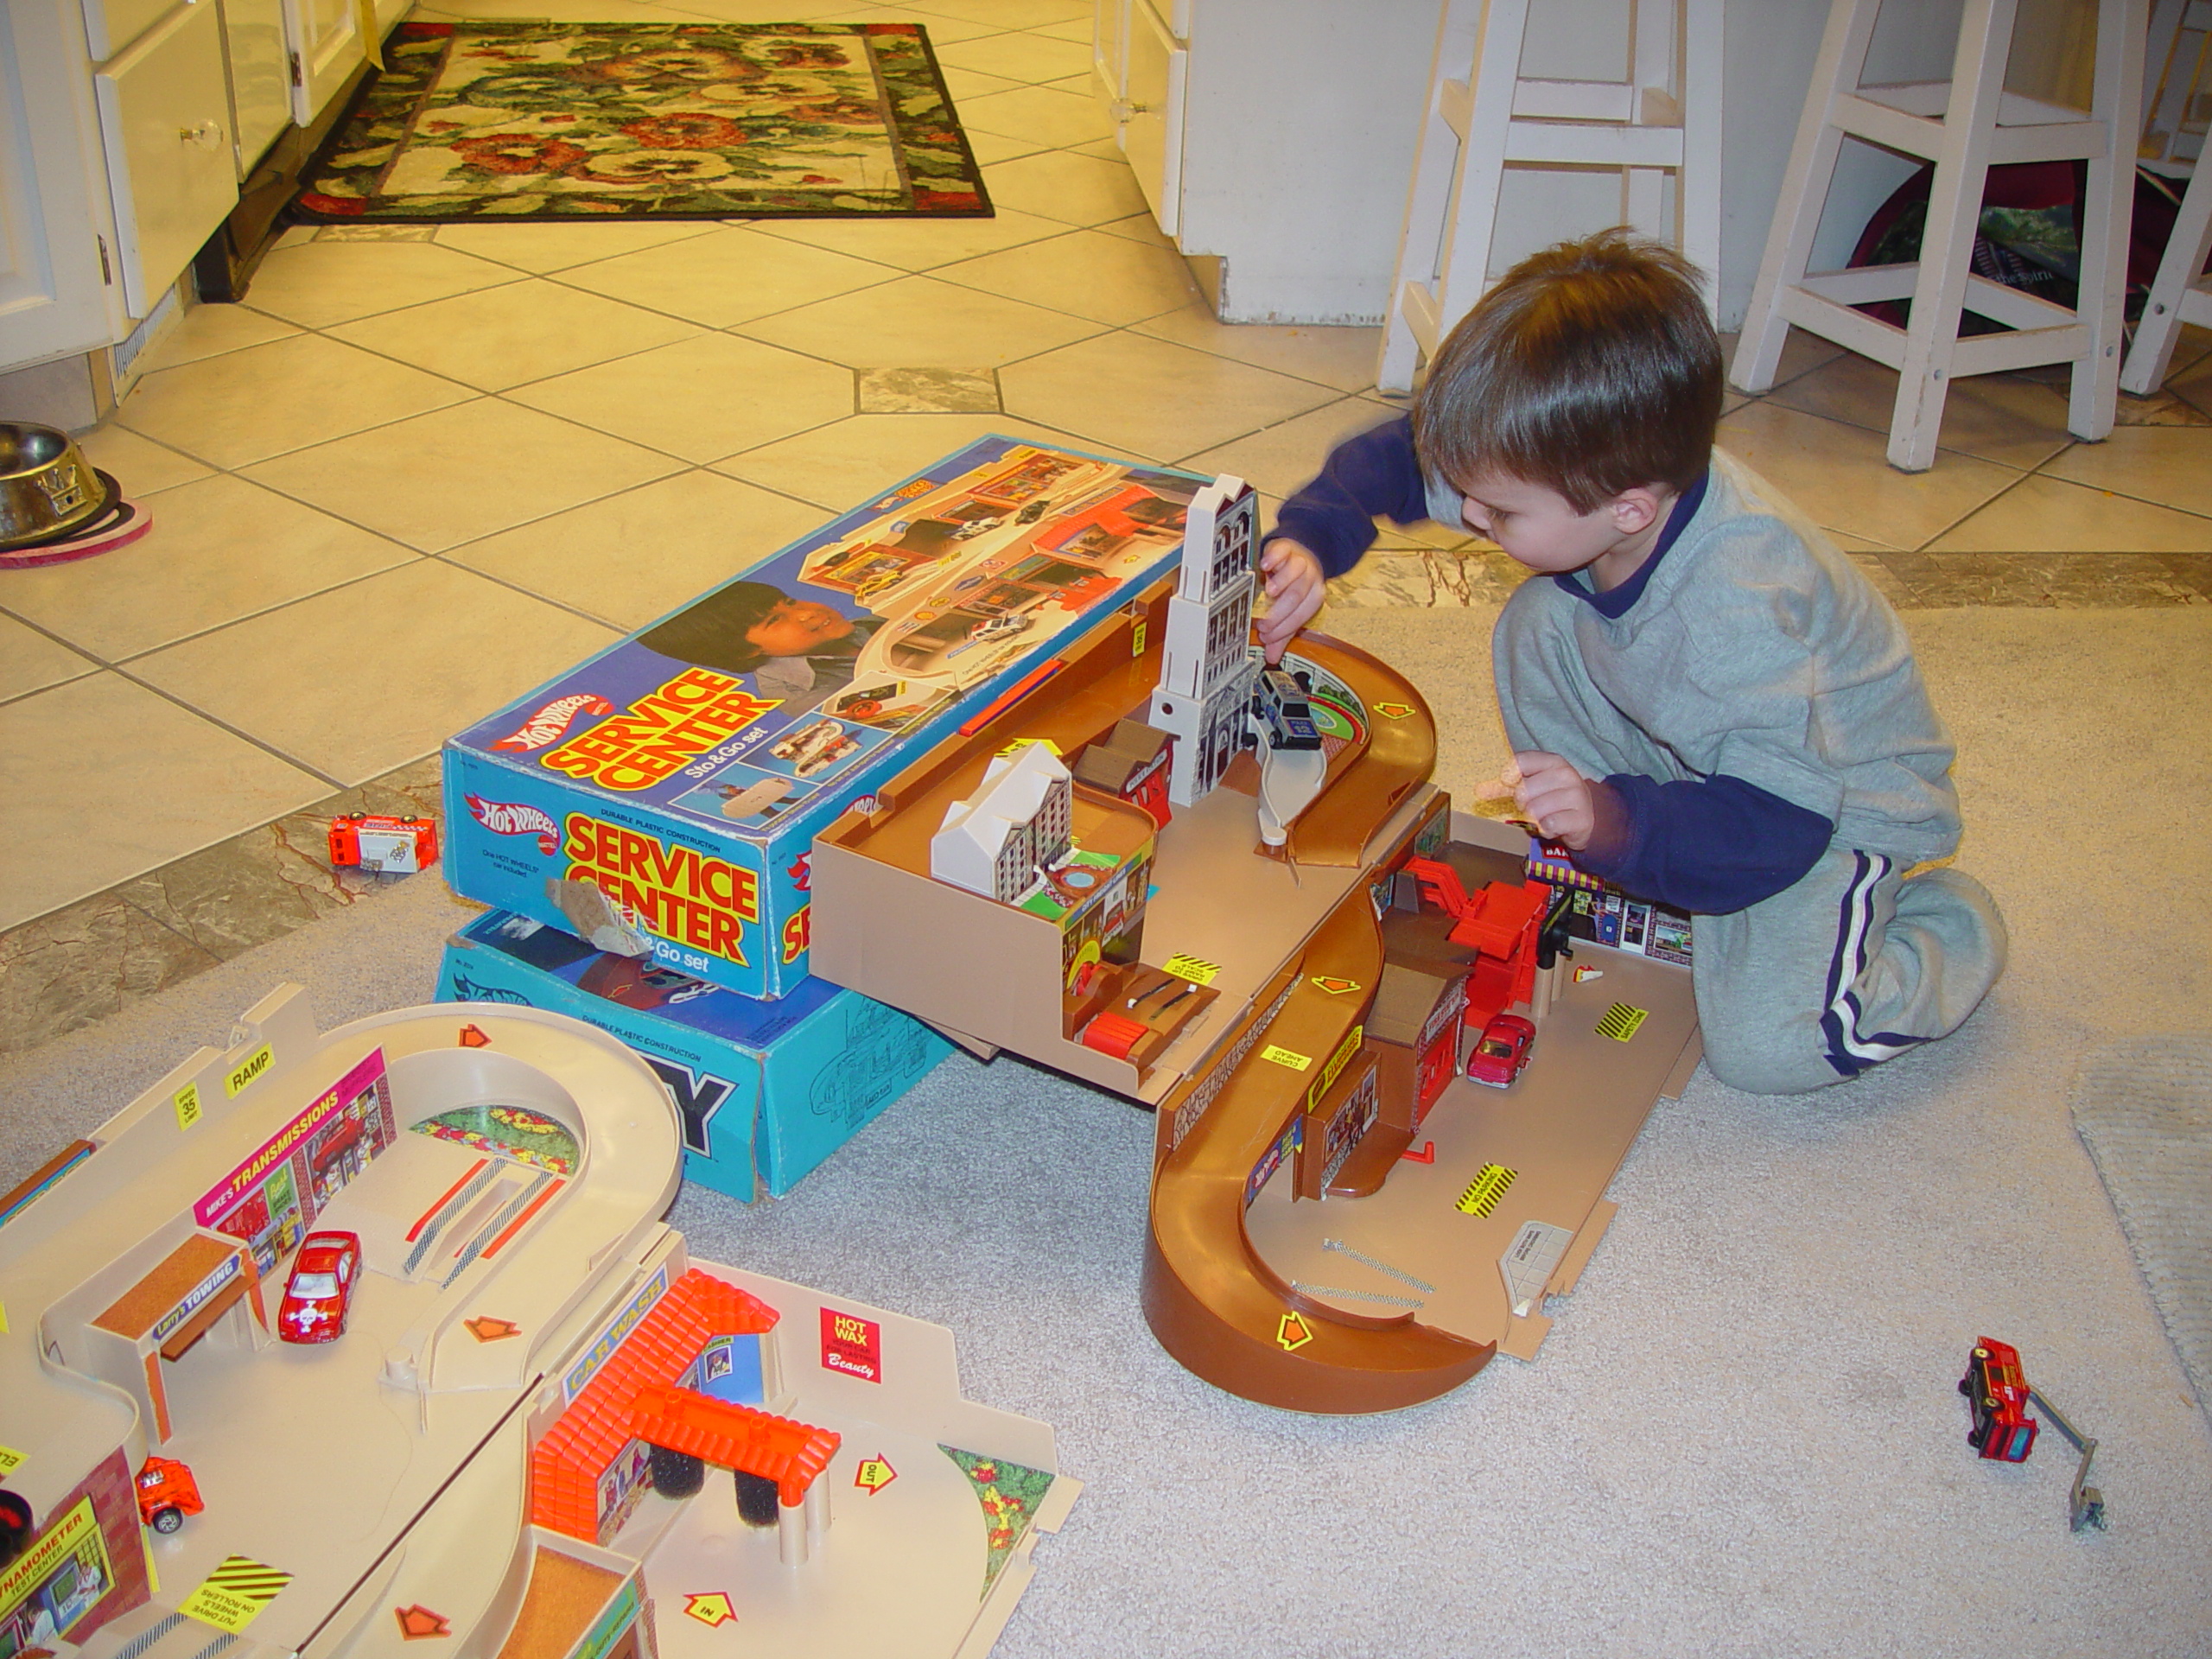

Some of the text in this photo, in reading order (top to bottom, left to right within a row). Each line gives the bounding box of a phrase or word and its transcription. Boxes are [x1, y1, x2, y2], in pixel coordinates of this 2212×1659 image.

[543, 668, 740, 778] SERVICE
[596, 692, 783, 790] CENTER
[744, 727, 769, 744] set
[601, 809, 721, 853] DURABLE PLASTIC CONSTRUCTION
[565, 814, 760, 922] SERVICE
[683, 953, 709, 973] set
[614, 1026, 644, 1043] PLASTIC
[644, 1037, 702, 1063] CONSTRUCTION
[1274, 1049, 1304, 1063] AHEAD
[232, 1051, 269, 1091] RAMP
[1270, 1054, 1299, 1068] CURVE
[182, 1097, 196, 1116] 35
[184, 1109, 198, 1124] LIMIT
[206, 1186, 234, 1218] MIKE'S
[232, 1090, 339, 1192] TRANSMISSIONS
[1478, 1172, 1498, 1196] PARKING
[185, 1262, 234, 1310] TOWING
[570, 1275, 663, 1391] CAR WASH
[834, 1326, 868, 1346] WAX
[835, 1315, 867, 1334] HOT
[828, 1352, 874, 1379] Beauty
[866, 1464, 877, 1483] OUT
[11, 1544, 64, 1597] TEST CENTER
[200, 1588, 256, 1614] ON ROLLERS
[202, 1599, 239, 1618] WHEELS
[700, 1605, 715, 1618] IN
[192, 1604, 237, 1627] PUT DRIVE
